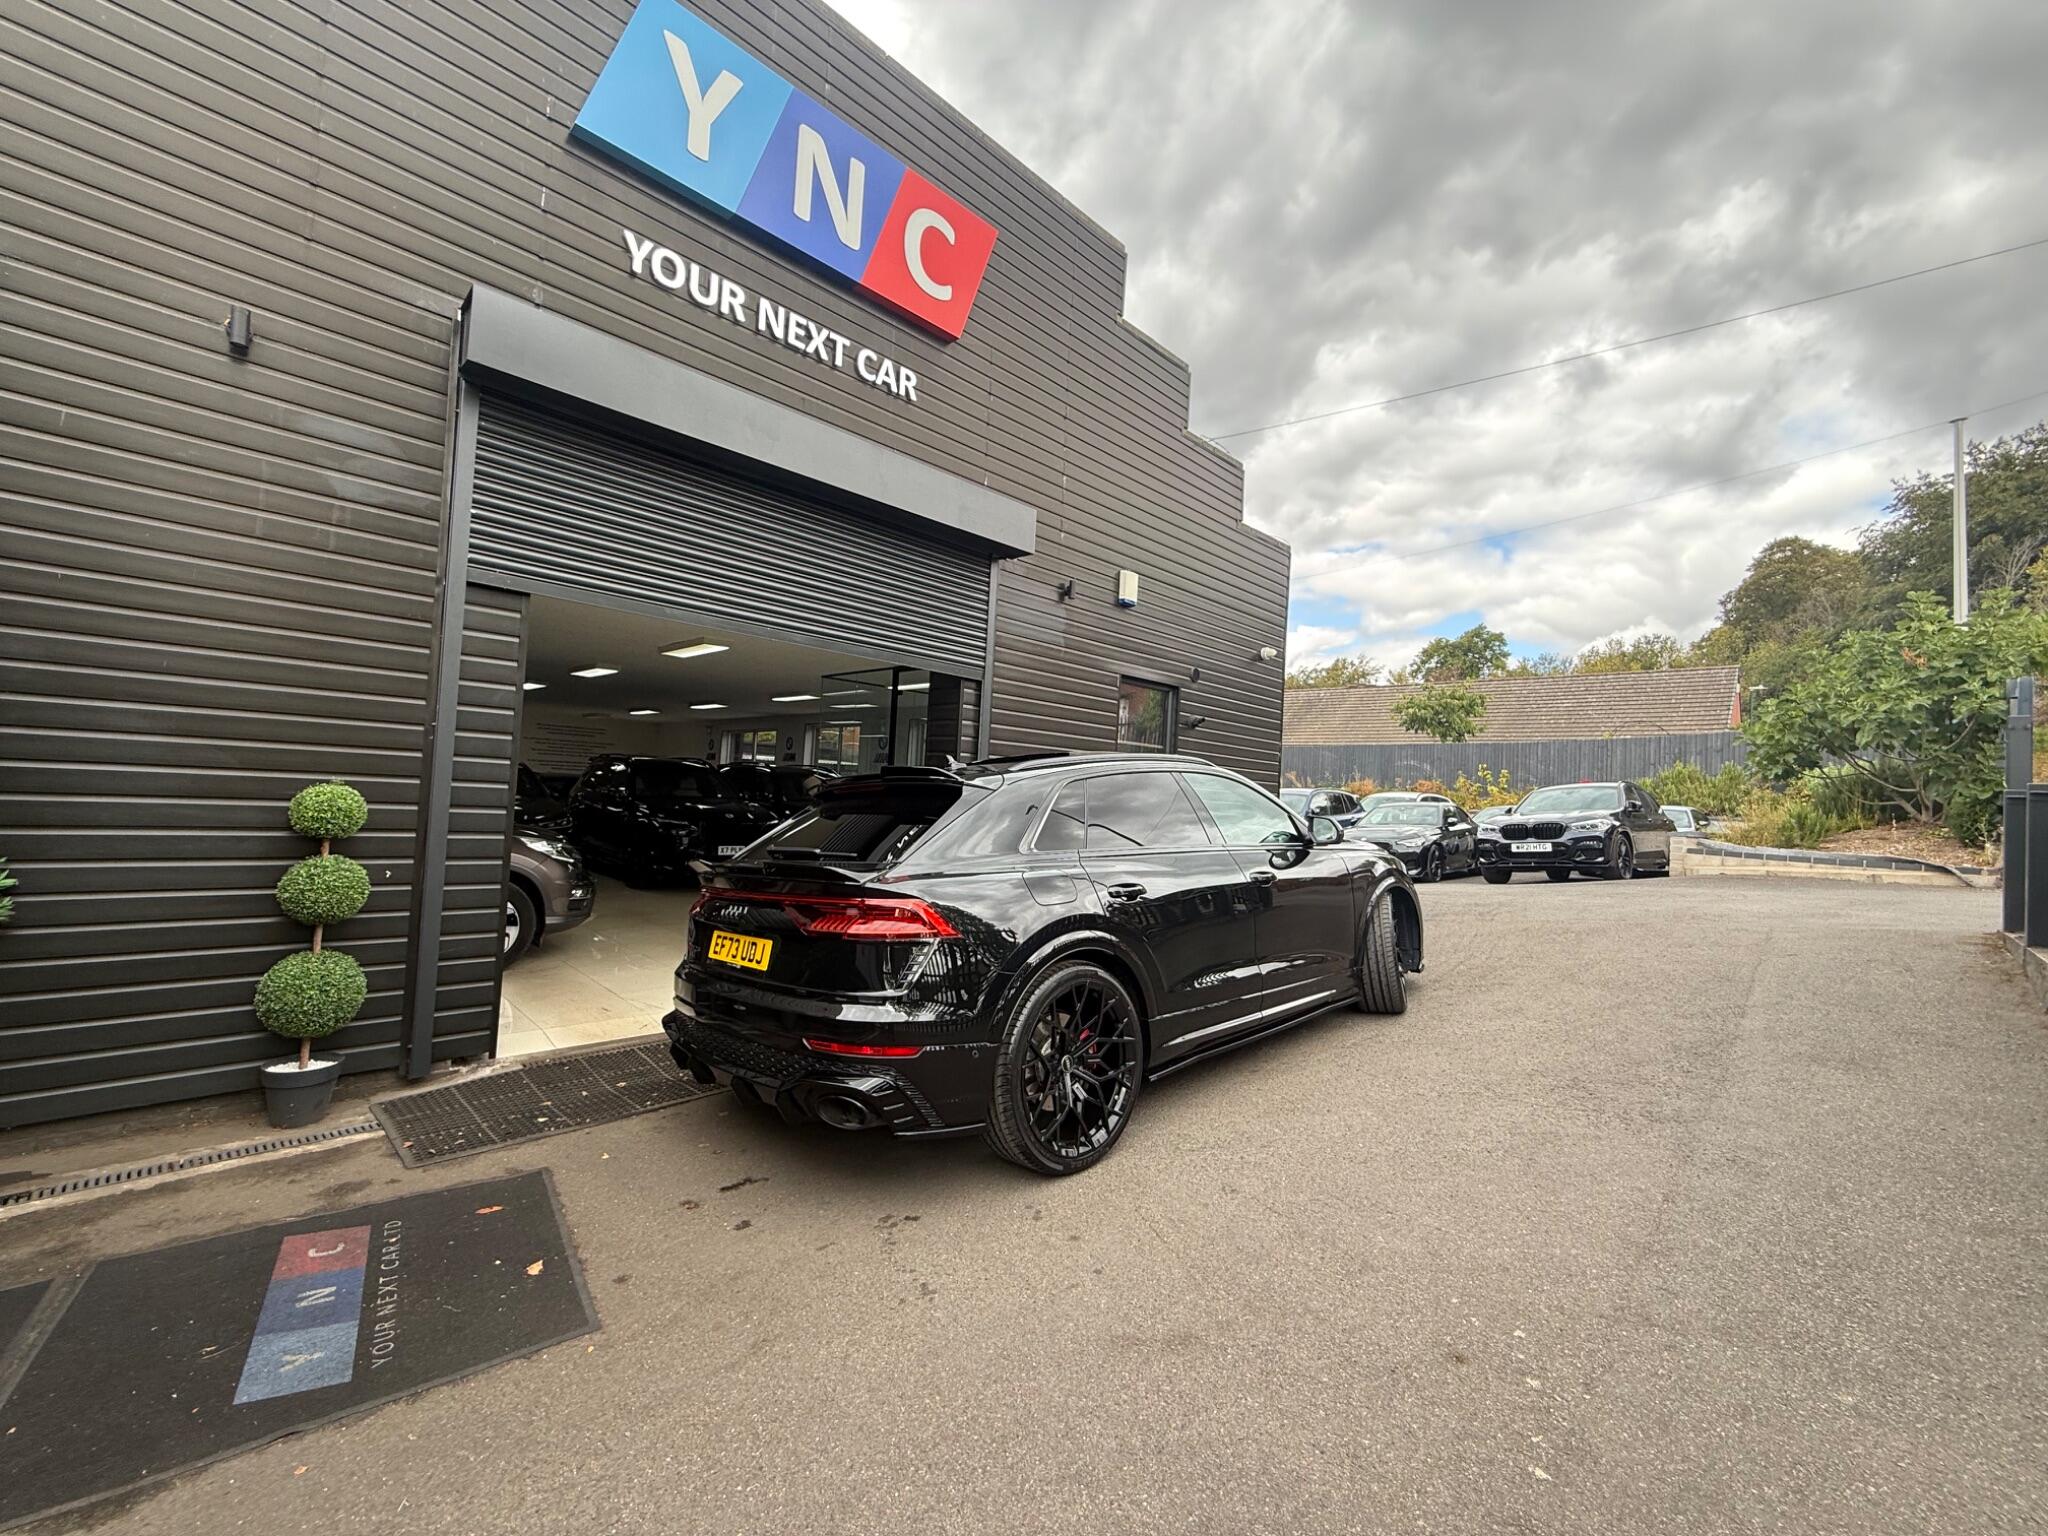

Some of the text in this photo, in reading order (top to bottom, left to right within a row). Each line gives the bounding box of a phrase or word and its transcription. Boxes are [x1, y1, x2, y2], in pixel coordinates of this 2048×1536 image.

[623, 229, 918, 402] YOUR NEXT CAR
[712, 934, 740, 959] EF73
[381, 1243, 400, 1270] CAR
[376, 1275, 399, 1317] NEXT
[371, 1319, 396, 1369] YOUR
